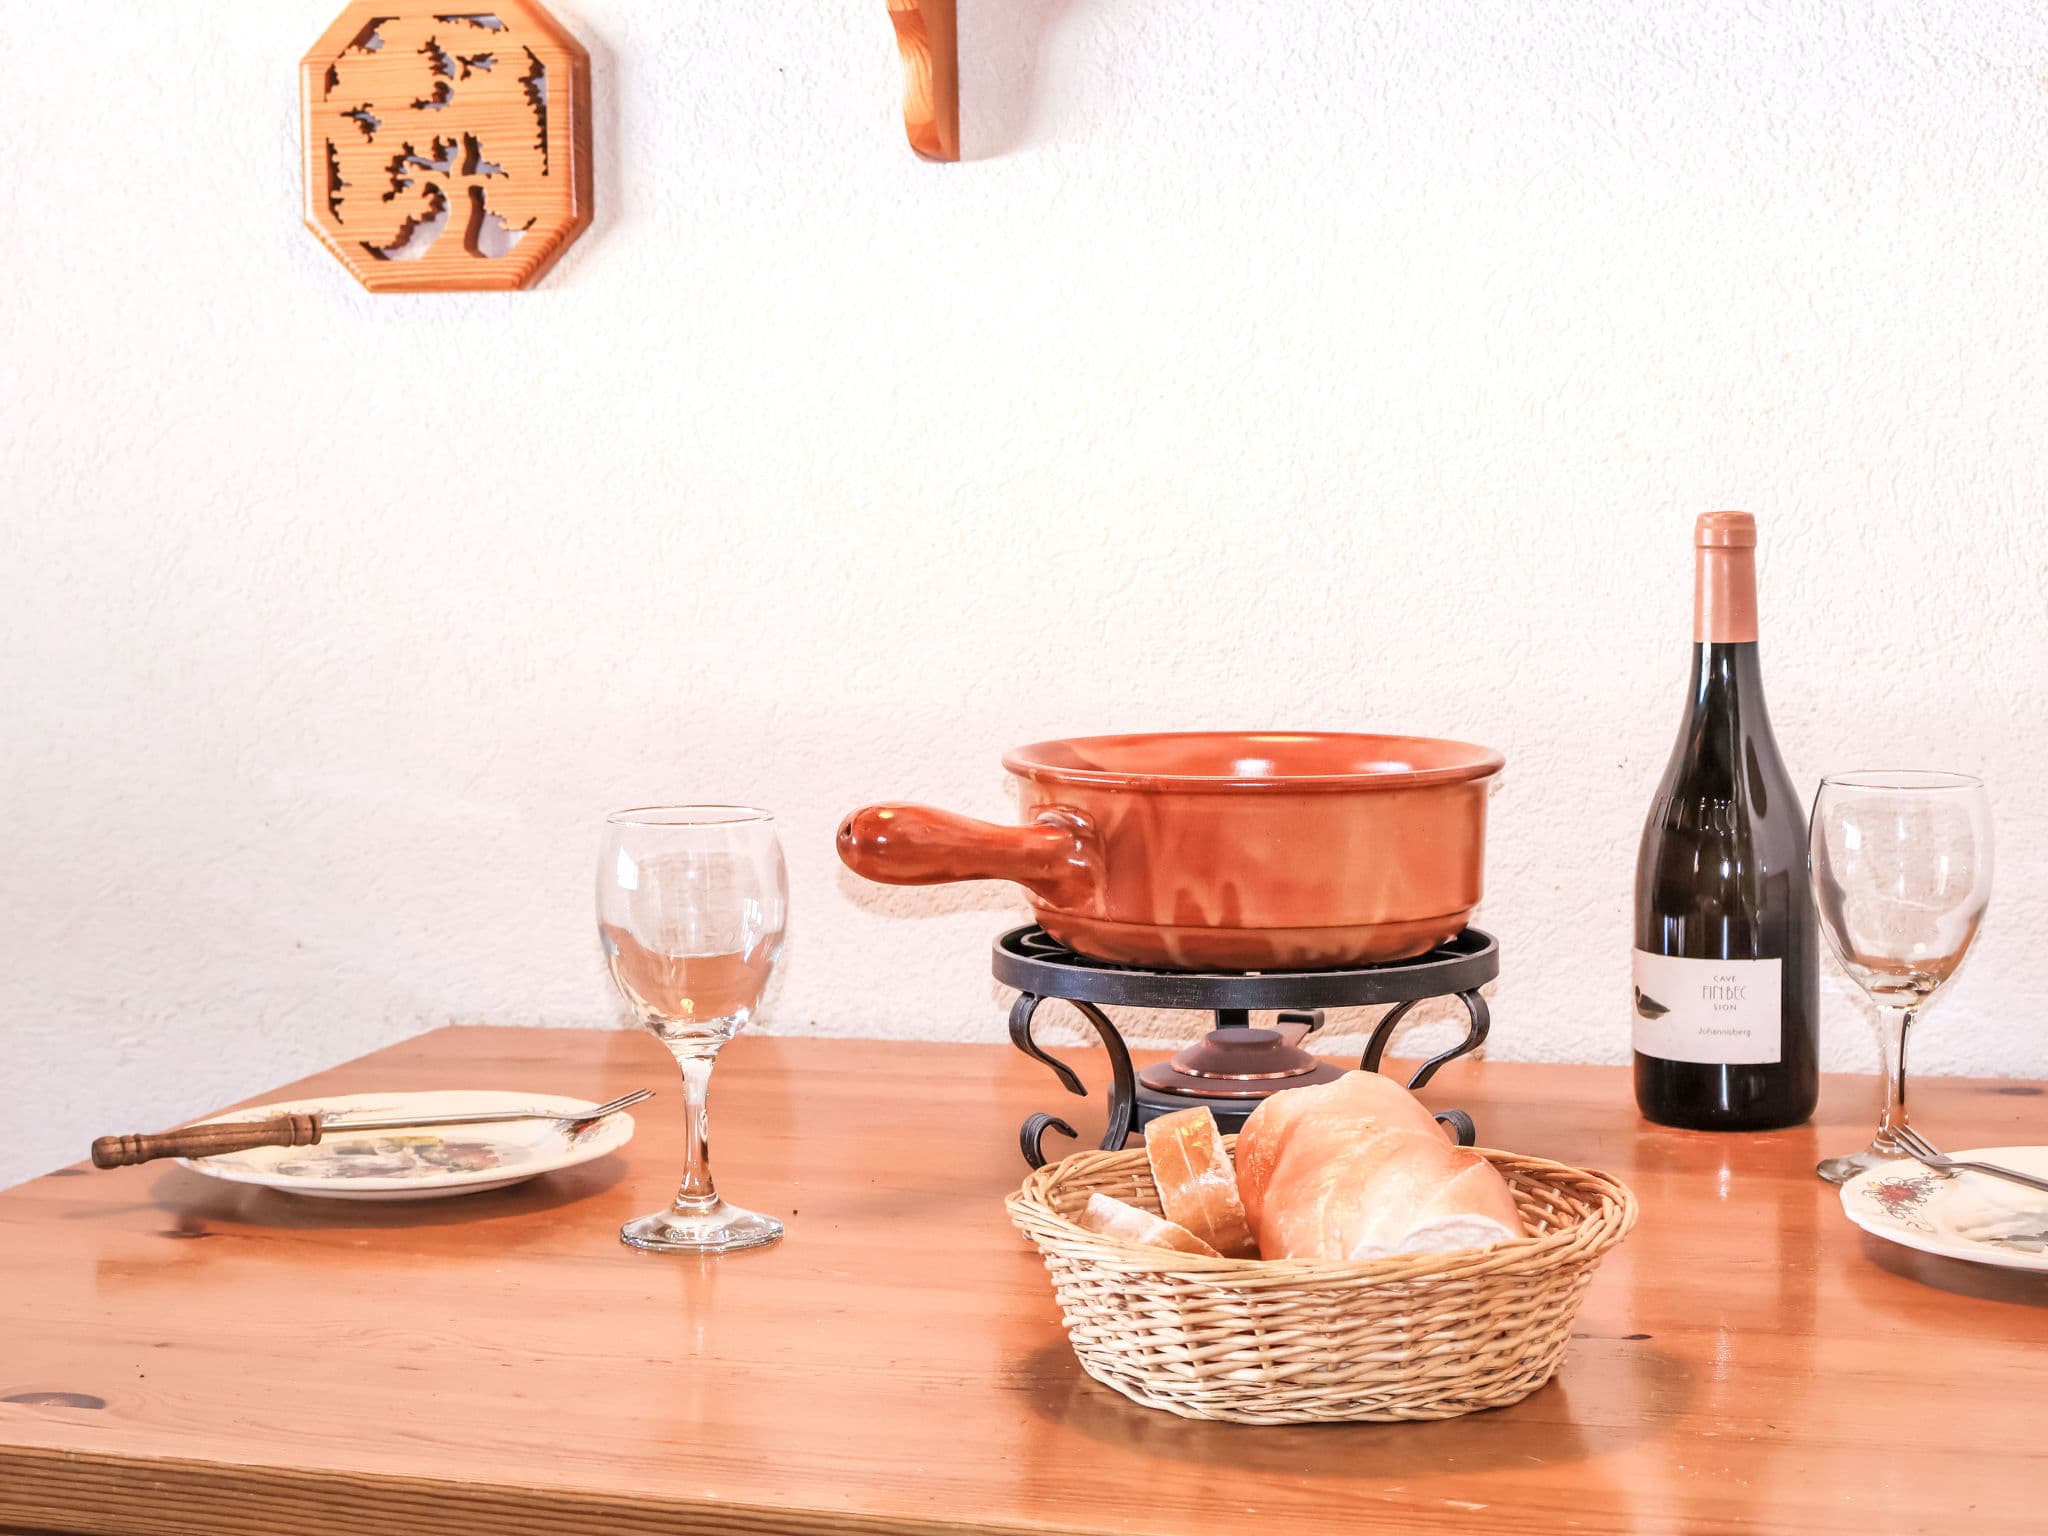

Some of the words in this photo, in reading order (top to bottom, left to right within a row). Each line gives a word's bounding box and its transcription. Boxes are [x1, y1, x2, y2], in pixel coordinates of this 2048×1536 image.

[1713, 975, 1737, 983] CAVE
[1713, 1003, 1737, 1012] SION
[1697, 1026, 1752, 1039] Johannisberg
